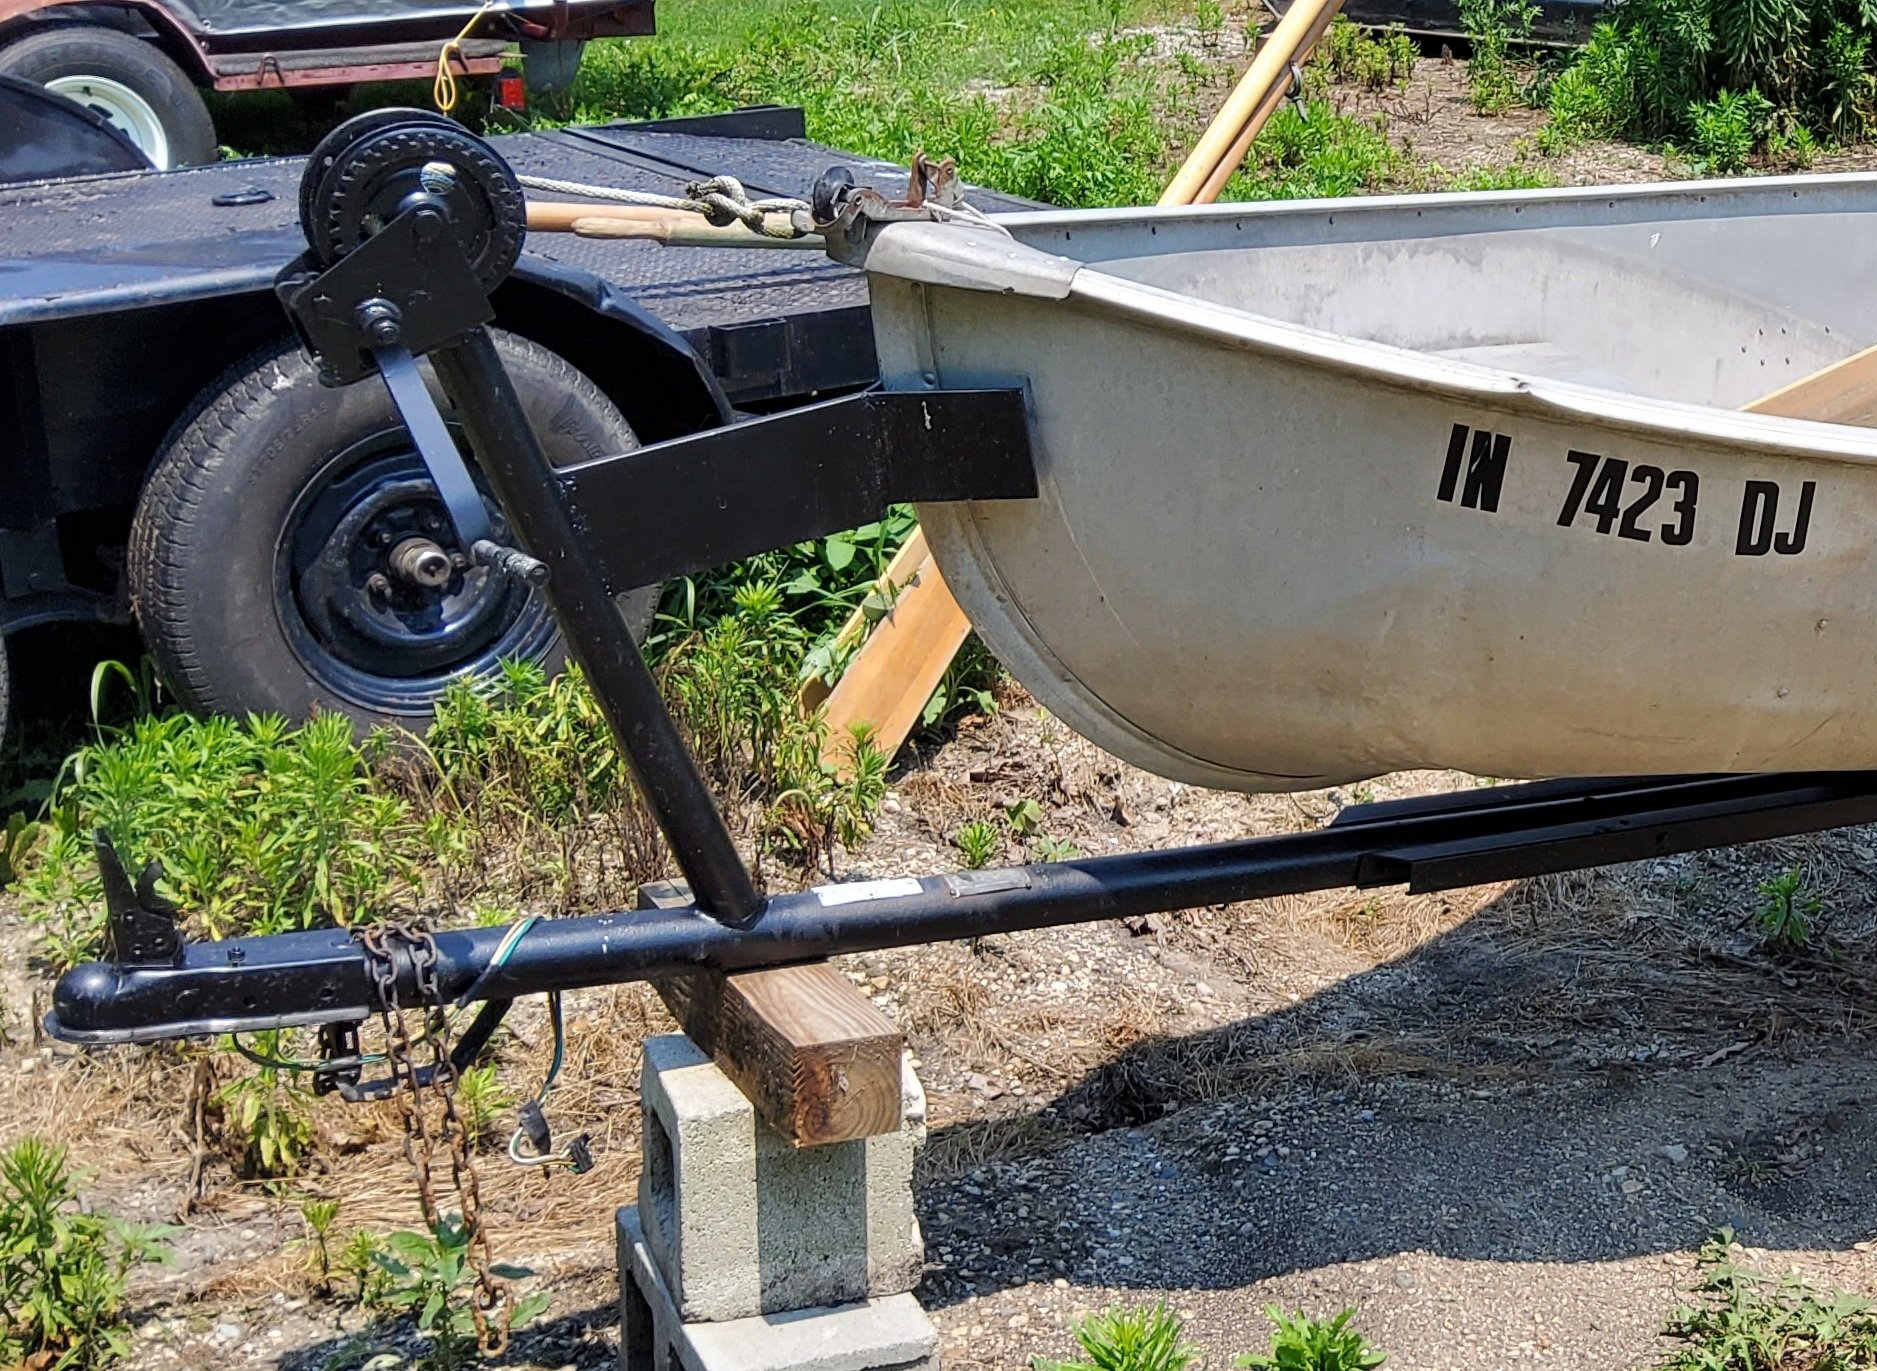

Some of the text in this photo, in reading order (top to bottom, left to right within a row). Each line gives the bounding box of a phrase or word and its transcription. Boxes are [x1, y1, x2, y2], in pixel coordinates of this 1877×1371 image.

[1437, 423, 1817, 556] IN 7423 DJ
